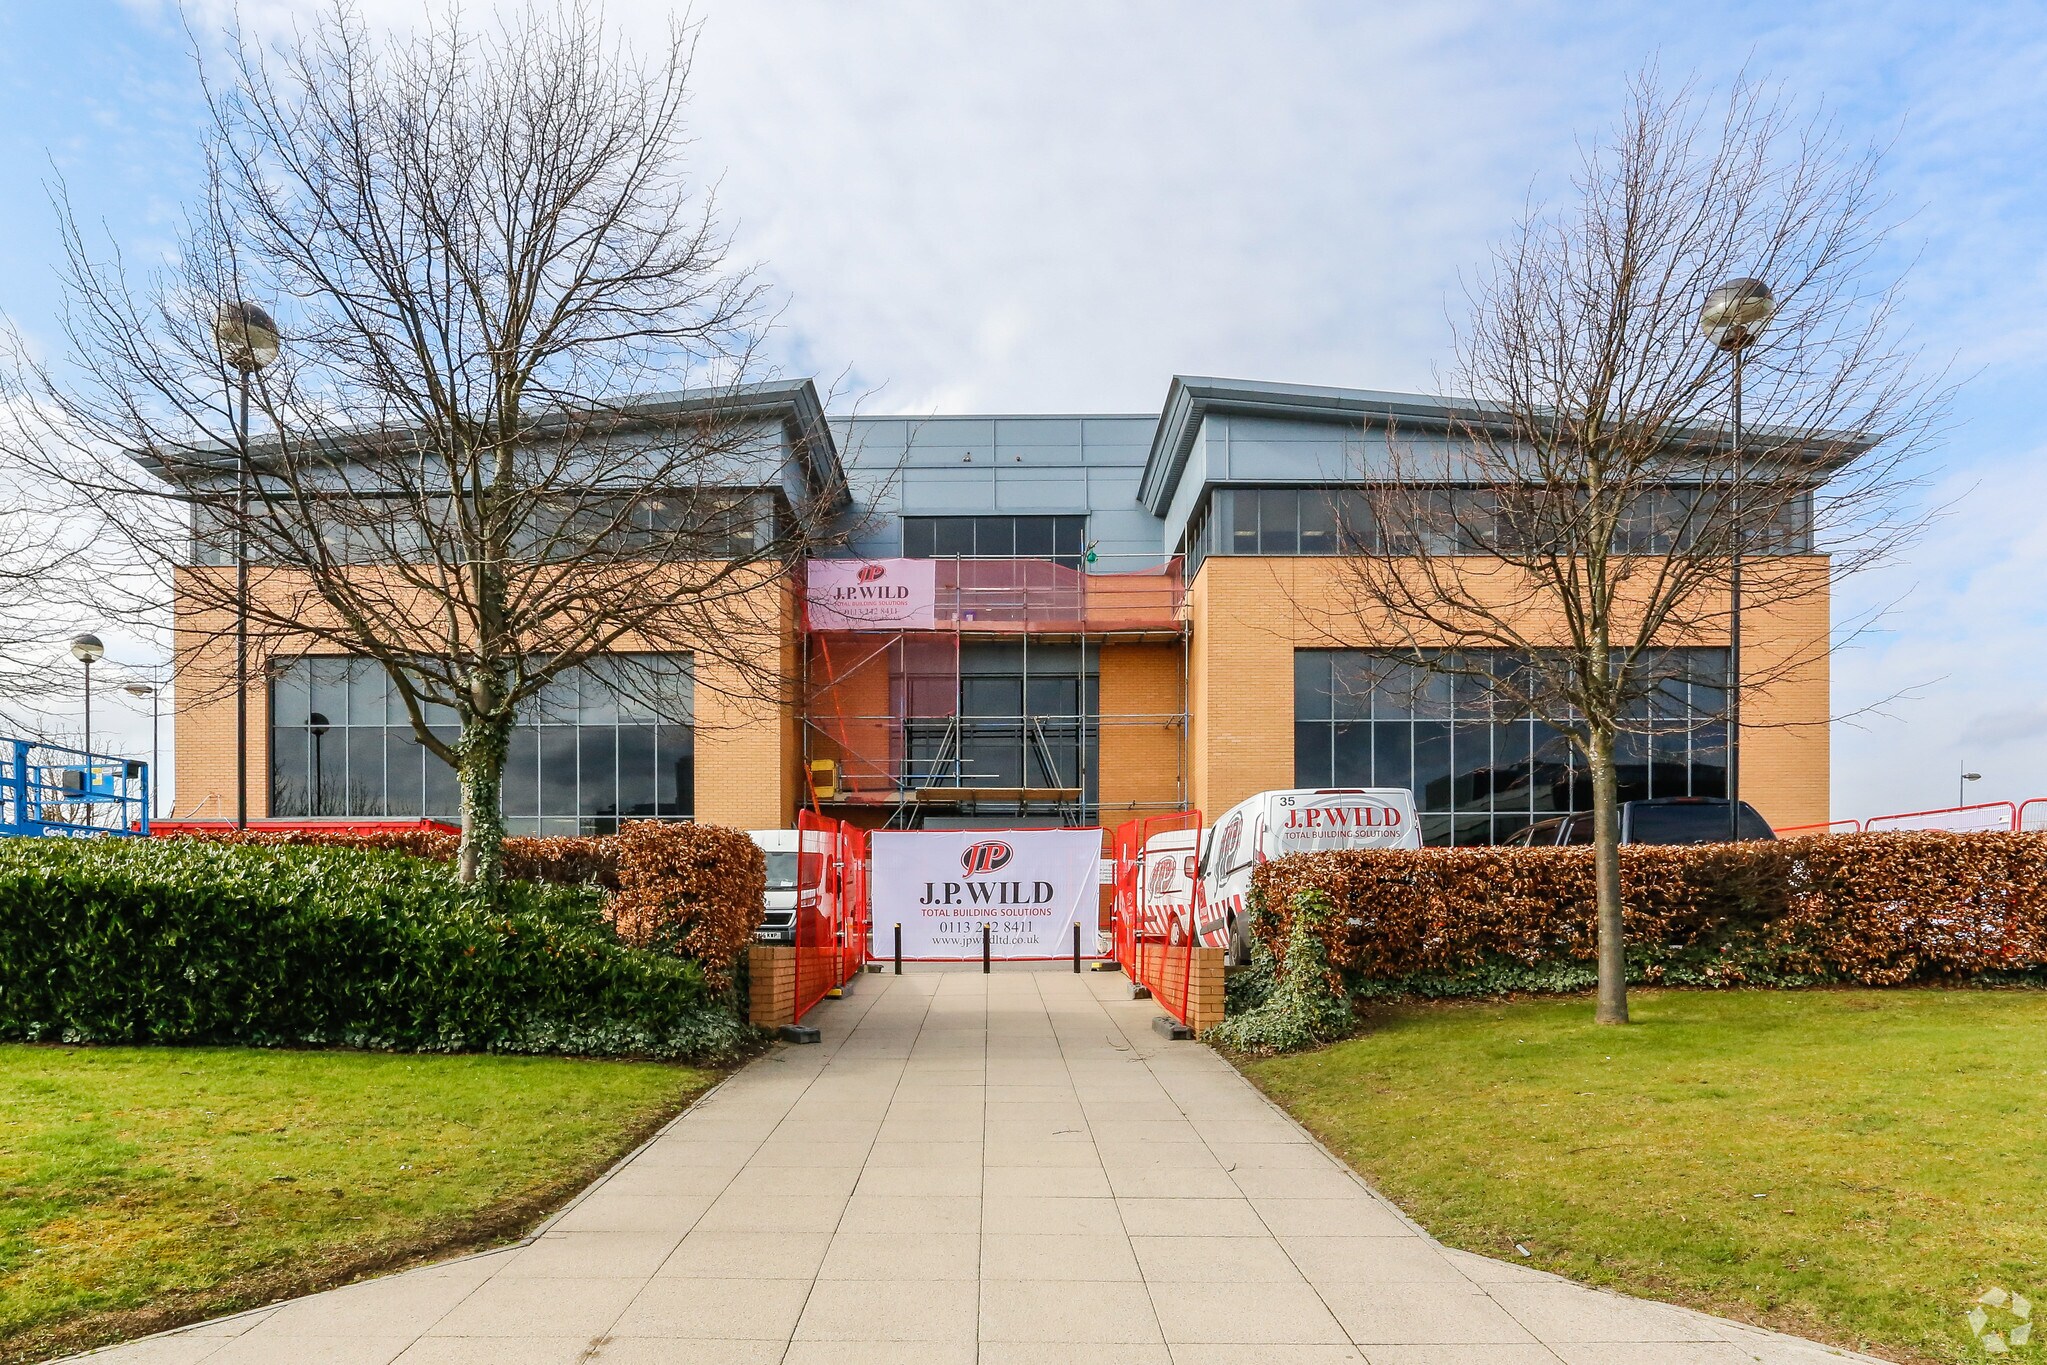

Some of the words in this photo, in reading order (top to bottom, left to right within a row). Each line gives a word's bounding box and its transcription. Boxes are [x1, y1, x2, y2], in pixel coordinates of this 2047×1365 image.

[1279, 796, 1296, 807] 35
[1285, 832, 1311, 840] TOTAL
[1312, 831, 1353, 839] BUILDING
[1354, 830, 1401, 838] SOLUTIONS
[962, 845, 1005, 878] JP
[921, 908, 950, 917] TOTAL
[953, 908, 998, 917] BUILDING
[1000, 907, 1052, 916] SOLUTIONS
[939, 921, 971, 933] 0113
[975, 921, 999, 933] 22
[1003, 920, 1033, 933] 8411
[932, 934, 1040, 948] www.jpwdltd.co.uk
